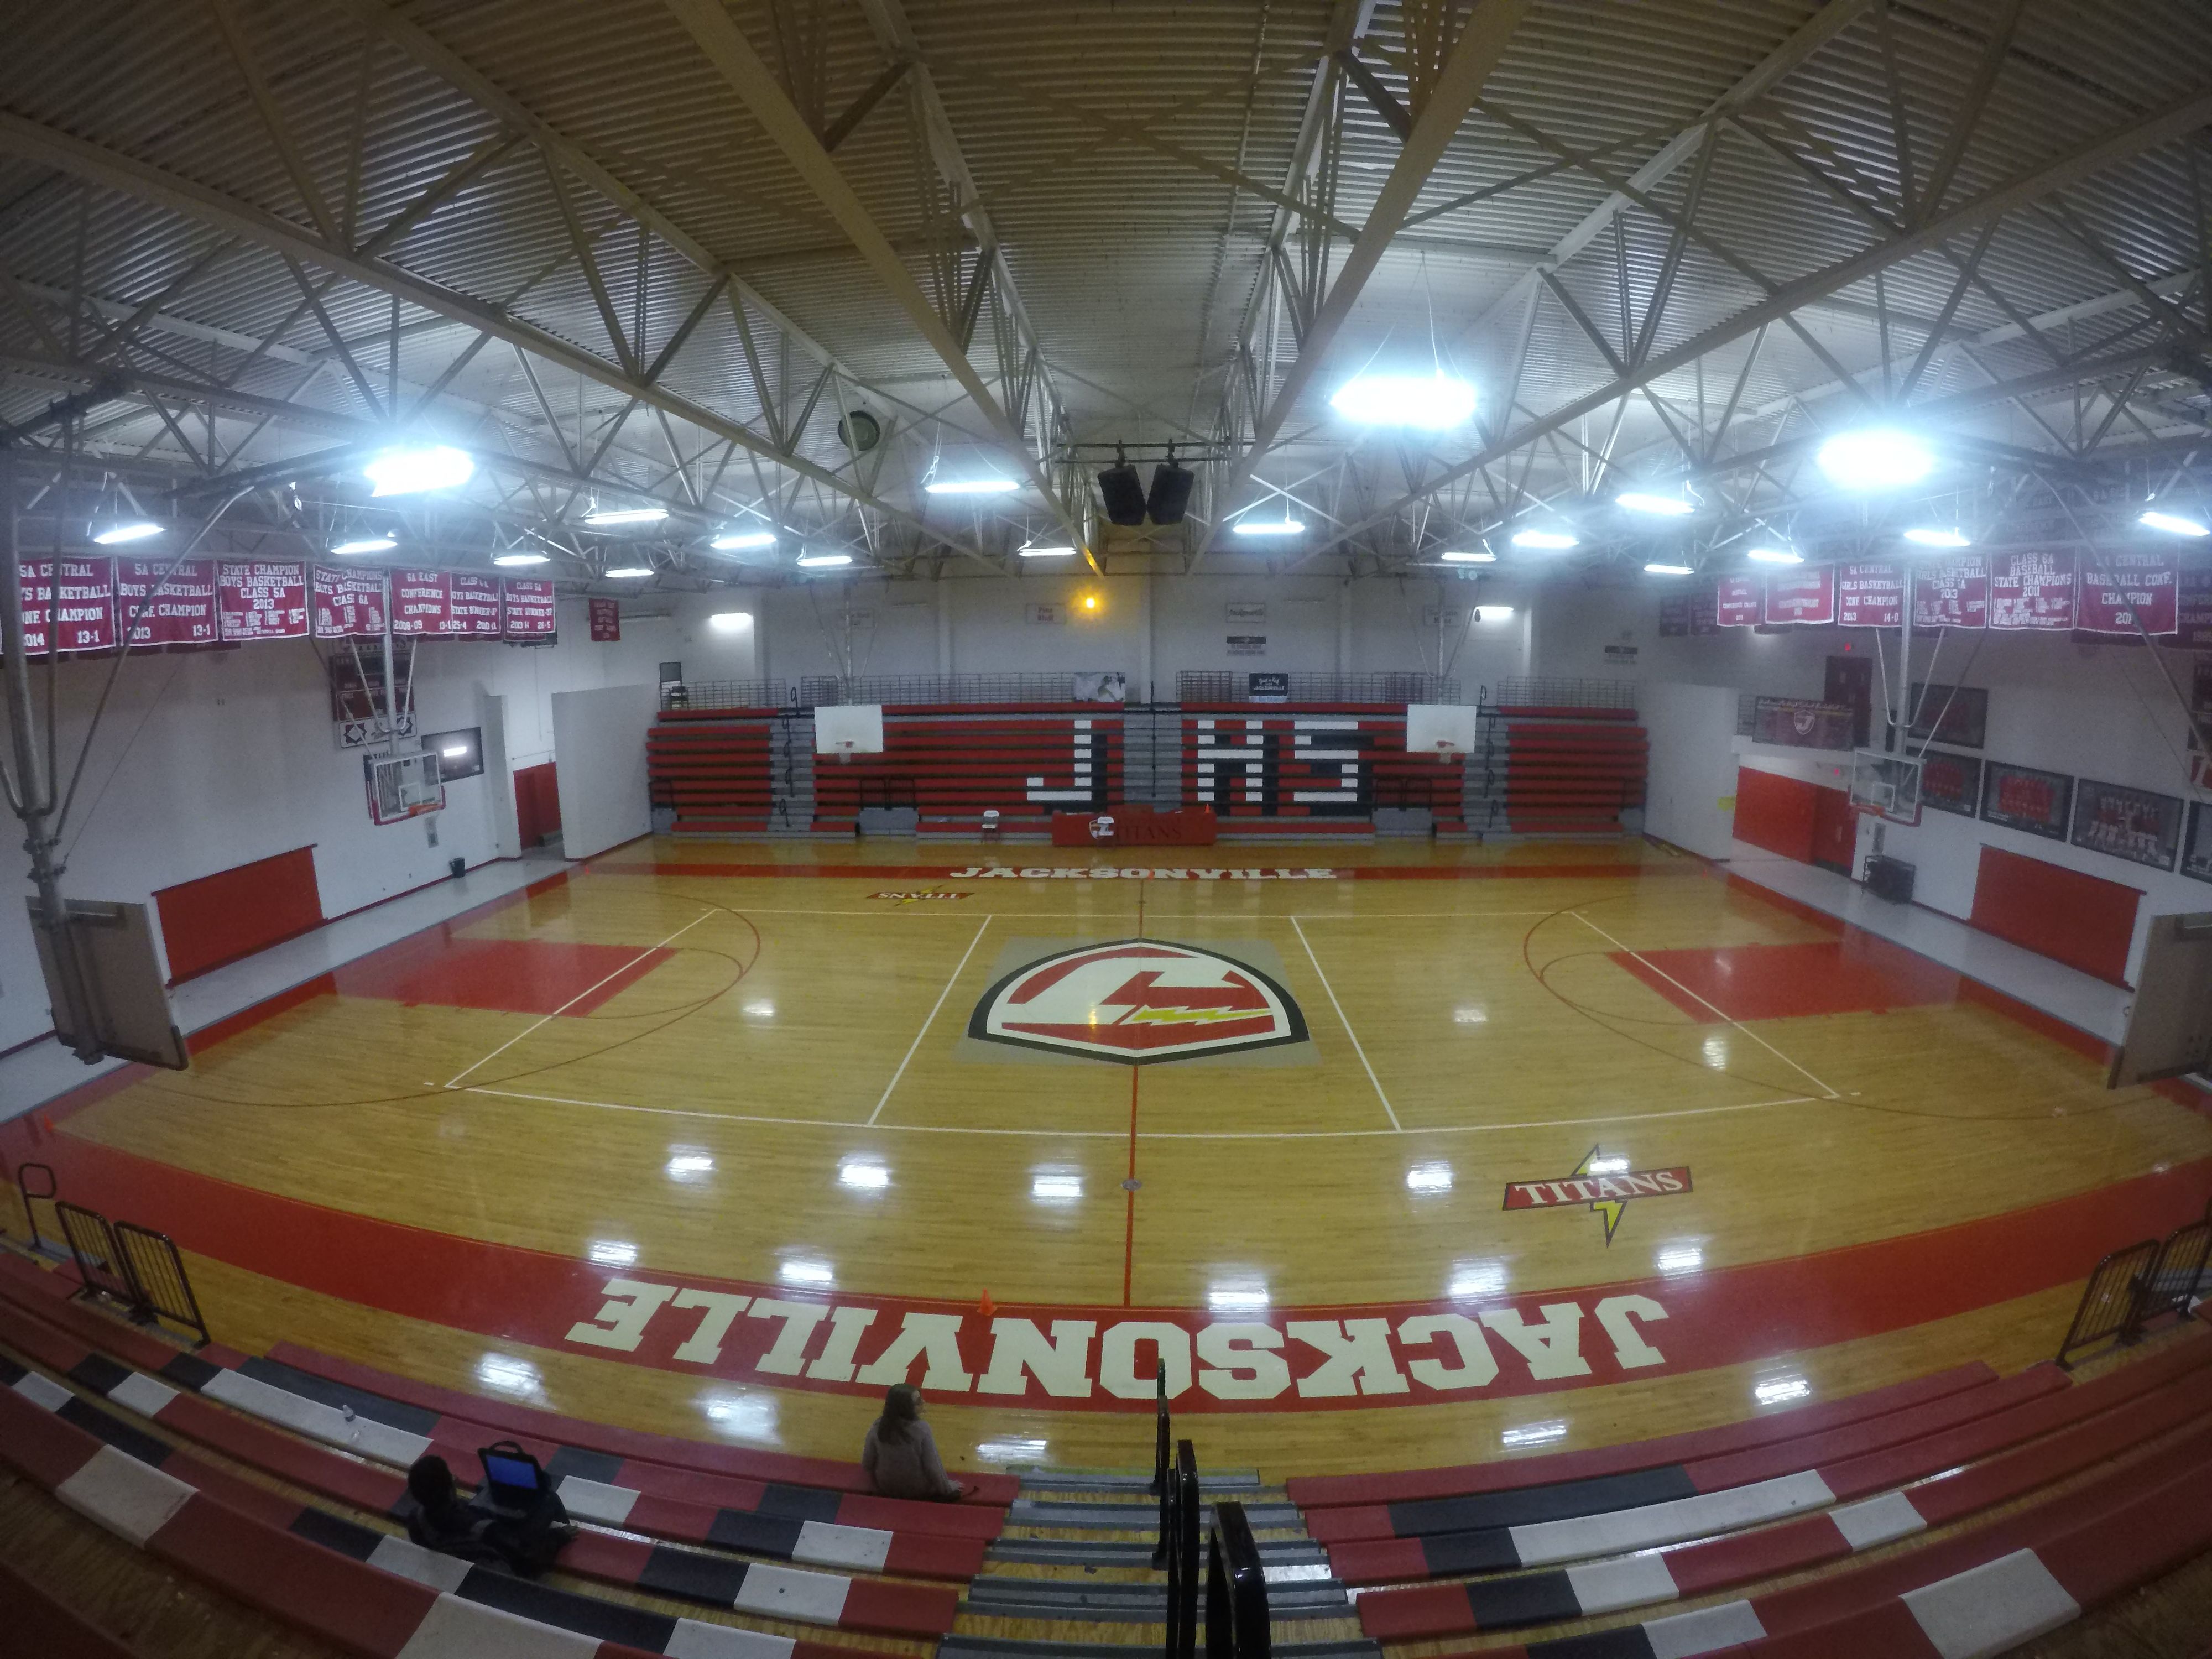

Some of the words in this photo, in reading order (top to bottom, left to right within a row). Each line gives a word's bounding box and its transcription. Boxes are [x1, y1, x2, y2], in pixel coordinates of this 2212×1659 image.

[2011, 552, 2038, 566] CLASS
[40, 564, 93, 576] CETRAL
[222, 564, 251, 576] STATE
[254, 564, 300, 576] CHAMPION
[2009, 564, 2056, 577] BASEBALL
[219, 575, 243, 587] BOYS
[246, 576, 304, 587] BASKETBALL
[419, 572, 439, 582] EAST
[1994, 576, 2020, 588] STATE
[2023, 573, 2072, 586] CHAMPIONS
[120, 583, 147, 597] BOYS
[151, 583, 213, 597] ASKETBALL
[1841, 581, 1858, 590] GIRLS
[1859, 579, 1903, 589] BASKETBALL
[37, 585, 111, 601] BAKETBALL
[241, 587, 269, 599] CLASS
[273, 587, 286, 598] 5A
[401, 588, 443, 599] CONFERENCE
[2022, 586, 2041, 597] 2011
[253, 598, 275, 610] 2013
[1863, 596, 1898, 606] CHAMPION
[158, 604, 206, 617] CHAMPION
[404, 604, 441, 614] CHAMPIONS
[1843, 612, 1857, 621] 2013
[77, 629, 100, 644] 13-1
[192, 624, 211, 637] 13-1
[950, 868, 1337, 879] JACKSONVILLE
[1514, 1171, 1683, 1204] TITANS
[564, 1279, 1670, 1401] JACKSONVILLE
